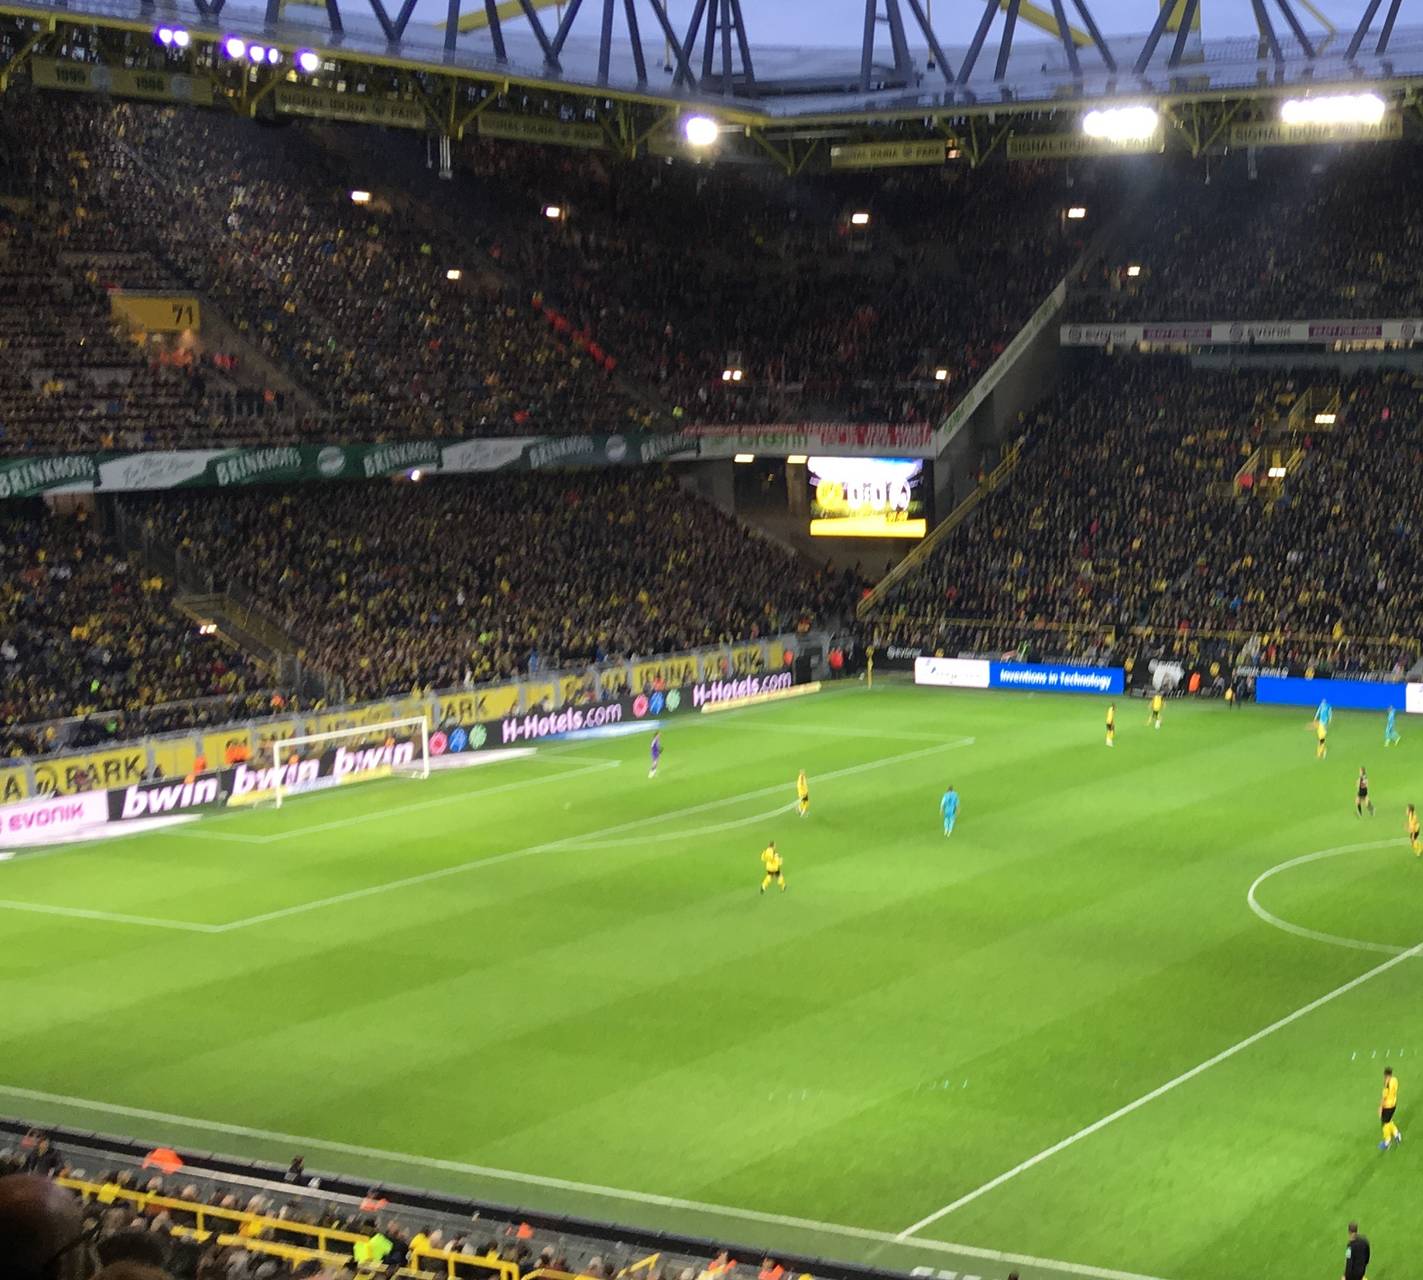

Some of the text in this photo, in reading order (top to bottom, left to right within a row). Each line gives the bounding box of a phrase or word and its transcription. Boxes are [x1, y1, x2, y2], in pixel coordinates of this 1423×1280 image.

[171, 303, 194, 325] 71
[692, 671, 793, 708] H-Hotels.com
[1000, 668, 1048, 685] Inventions
[1048, 671, 1058, 686] in
[1059, 671, 1112, 691] Technology
[502, 703, 622, 744] H-Hotels.com
[65, 754, 142, 795] PARK
[333, 740, 414, 778] bwin
[121, 777, 218, 819] bwin
[232, 763, 320, 796] bwin
